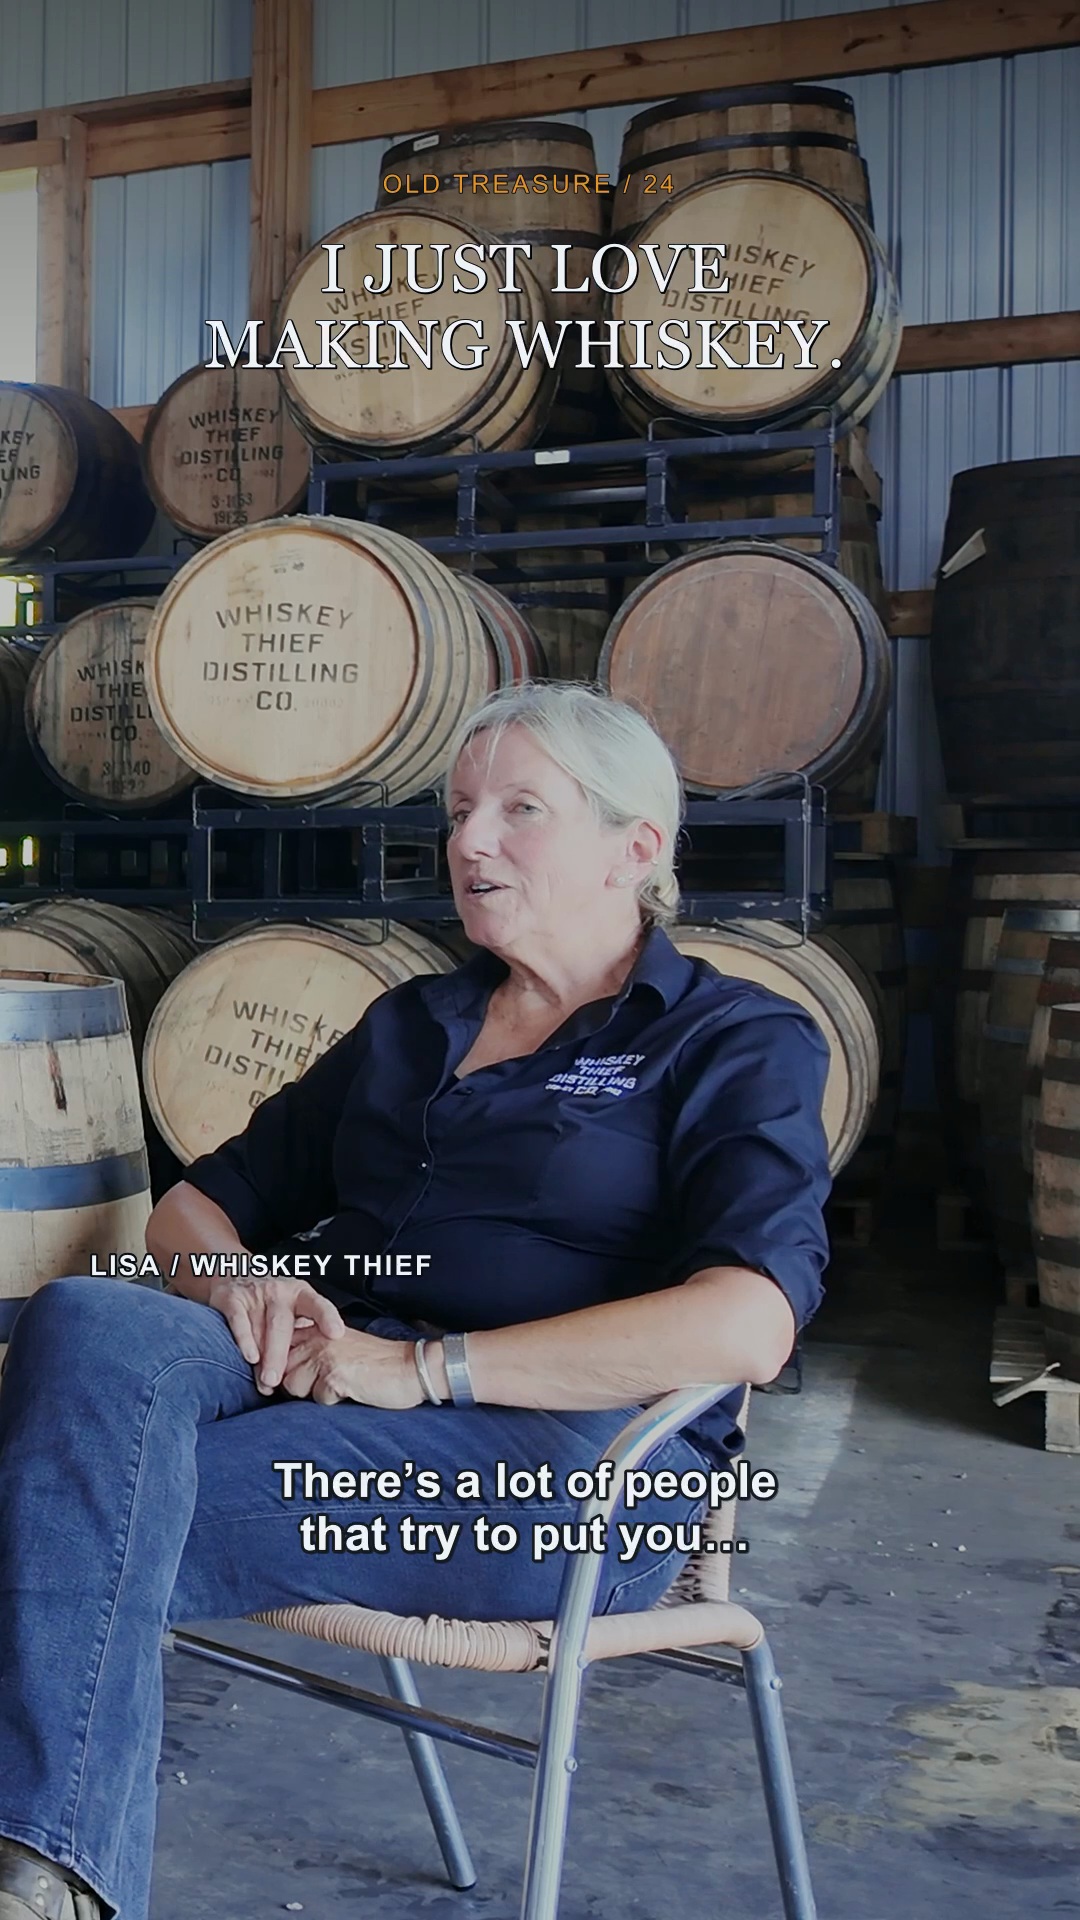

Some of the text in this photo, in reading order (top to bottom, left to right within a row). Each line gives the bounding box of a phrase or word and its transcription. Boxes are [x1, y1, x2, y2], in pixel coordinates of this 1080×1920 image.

[353, 297, 425, 329] THIEF
[188, 408, 279, 430] WHISKEY
[206, 427, 261, 444] THIEF
[215, 603, 354, 630] WHISKEY
[242, 633, 325, 653] THIEF
[77, 659, 145, 682] WHISK
[203, 661, 360, 684] DISTILLING
[96, 681, 148, 699] THIE
[256, 690, 298, 711] CO.
[70, 704, 153, 722] DISTILLI
[232, 1000, 345, 1048] WHISKE
[204, 1044, 286, 1087] DISTIL
[574, 1054, 646, 1067] WHISKEY
[580, 1065, 627, 1076] THIEF
[547, 1073, 638, 1090] DISTILLING
